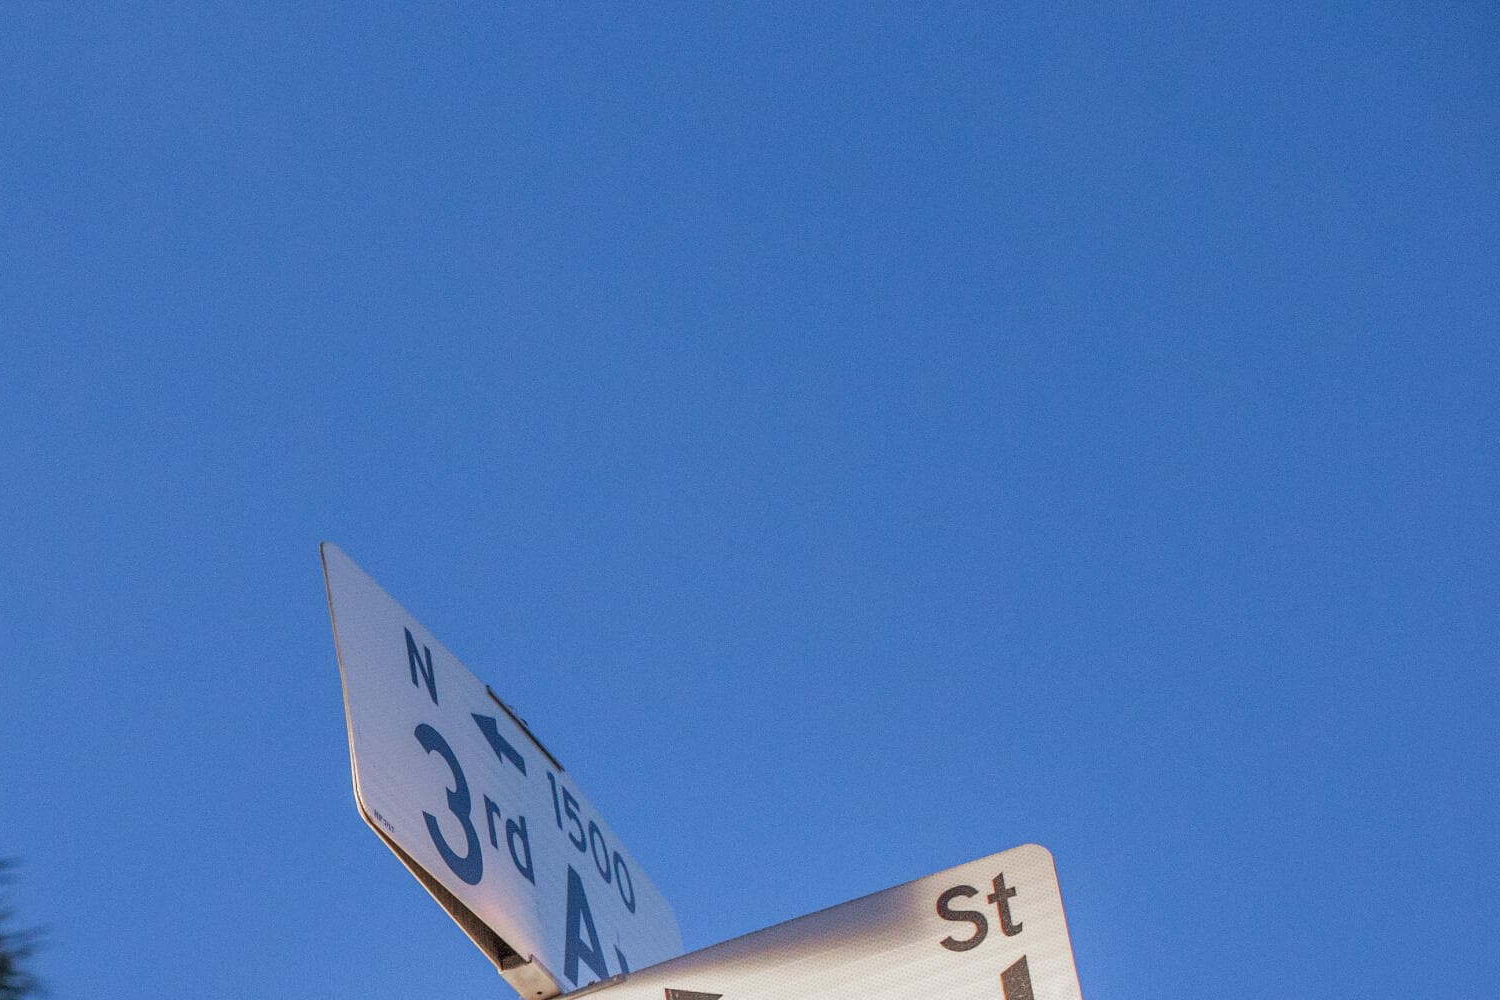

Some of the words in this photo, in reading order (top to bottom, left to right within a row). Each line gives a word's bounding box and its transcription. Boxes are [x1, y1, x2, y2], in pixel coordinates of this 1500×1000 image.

[403, 627, 439, 706] N
[546, 771, 636, 914] 1500
[414, 722, 536, 886] 3rd
[935, 871, 1025, 953] St
